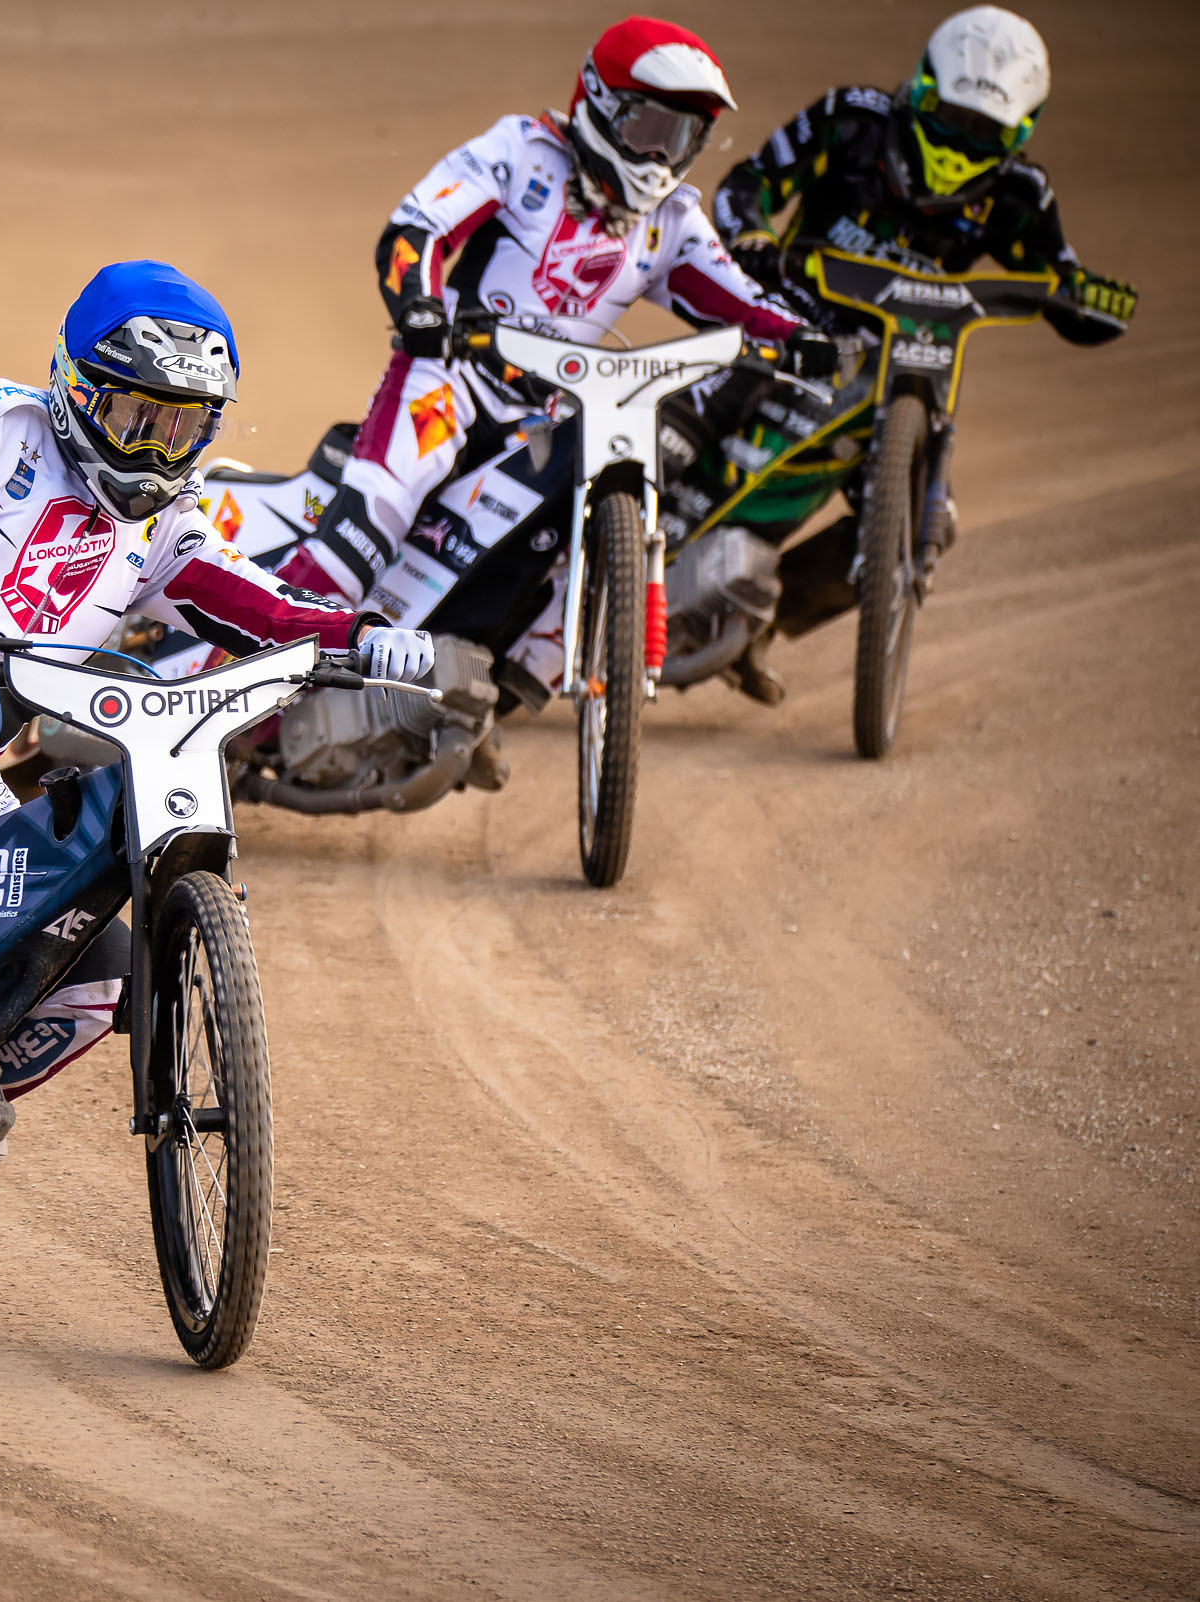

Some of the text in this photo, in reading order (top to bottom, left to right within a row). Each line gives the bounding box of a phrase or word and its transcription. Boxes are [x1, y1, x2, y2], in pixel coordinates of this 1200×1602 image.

[163, 357, 217, 377] Arai
[597, 358, 686, 379] OPTIBET
[86, 391, 100, 416] OAKLEY
[28, 537, 111, 561] LOKOMOTIV
[141, 689, 251, 717] OPTIBET
[10, 849, 26, 905] LOGISTICS
